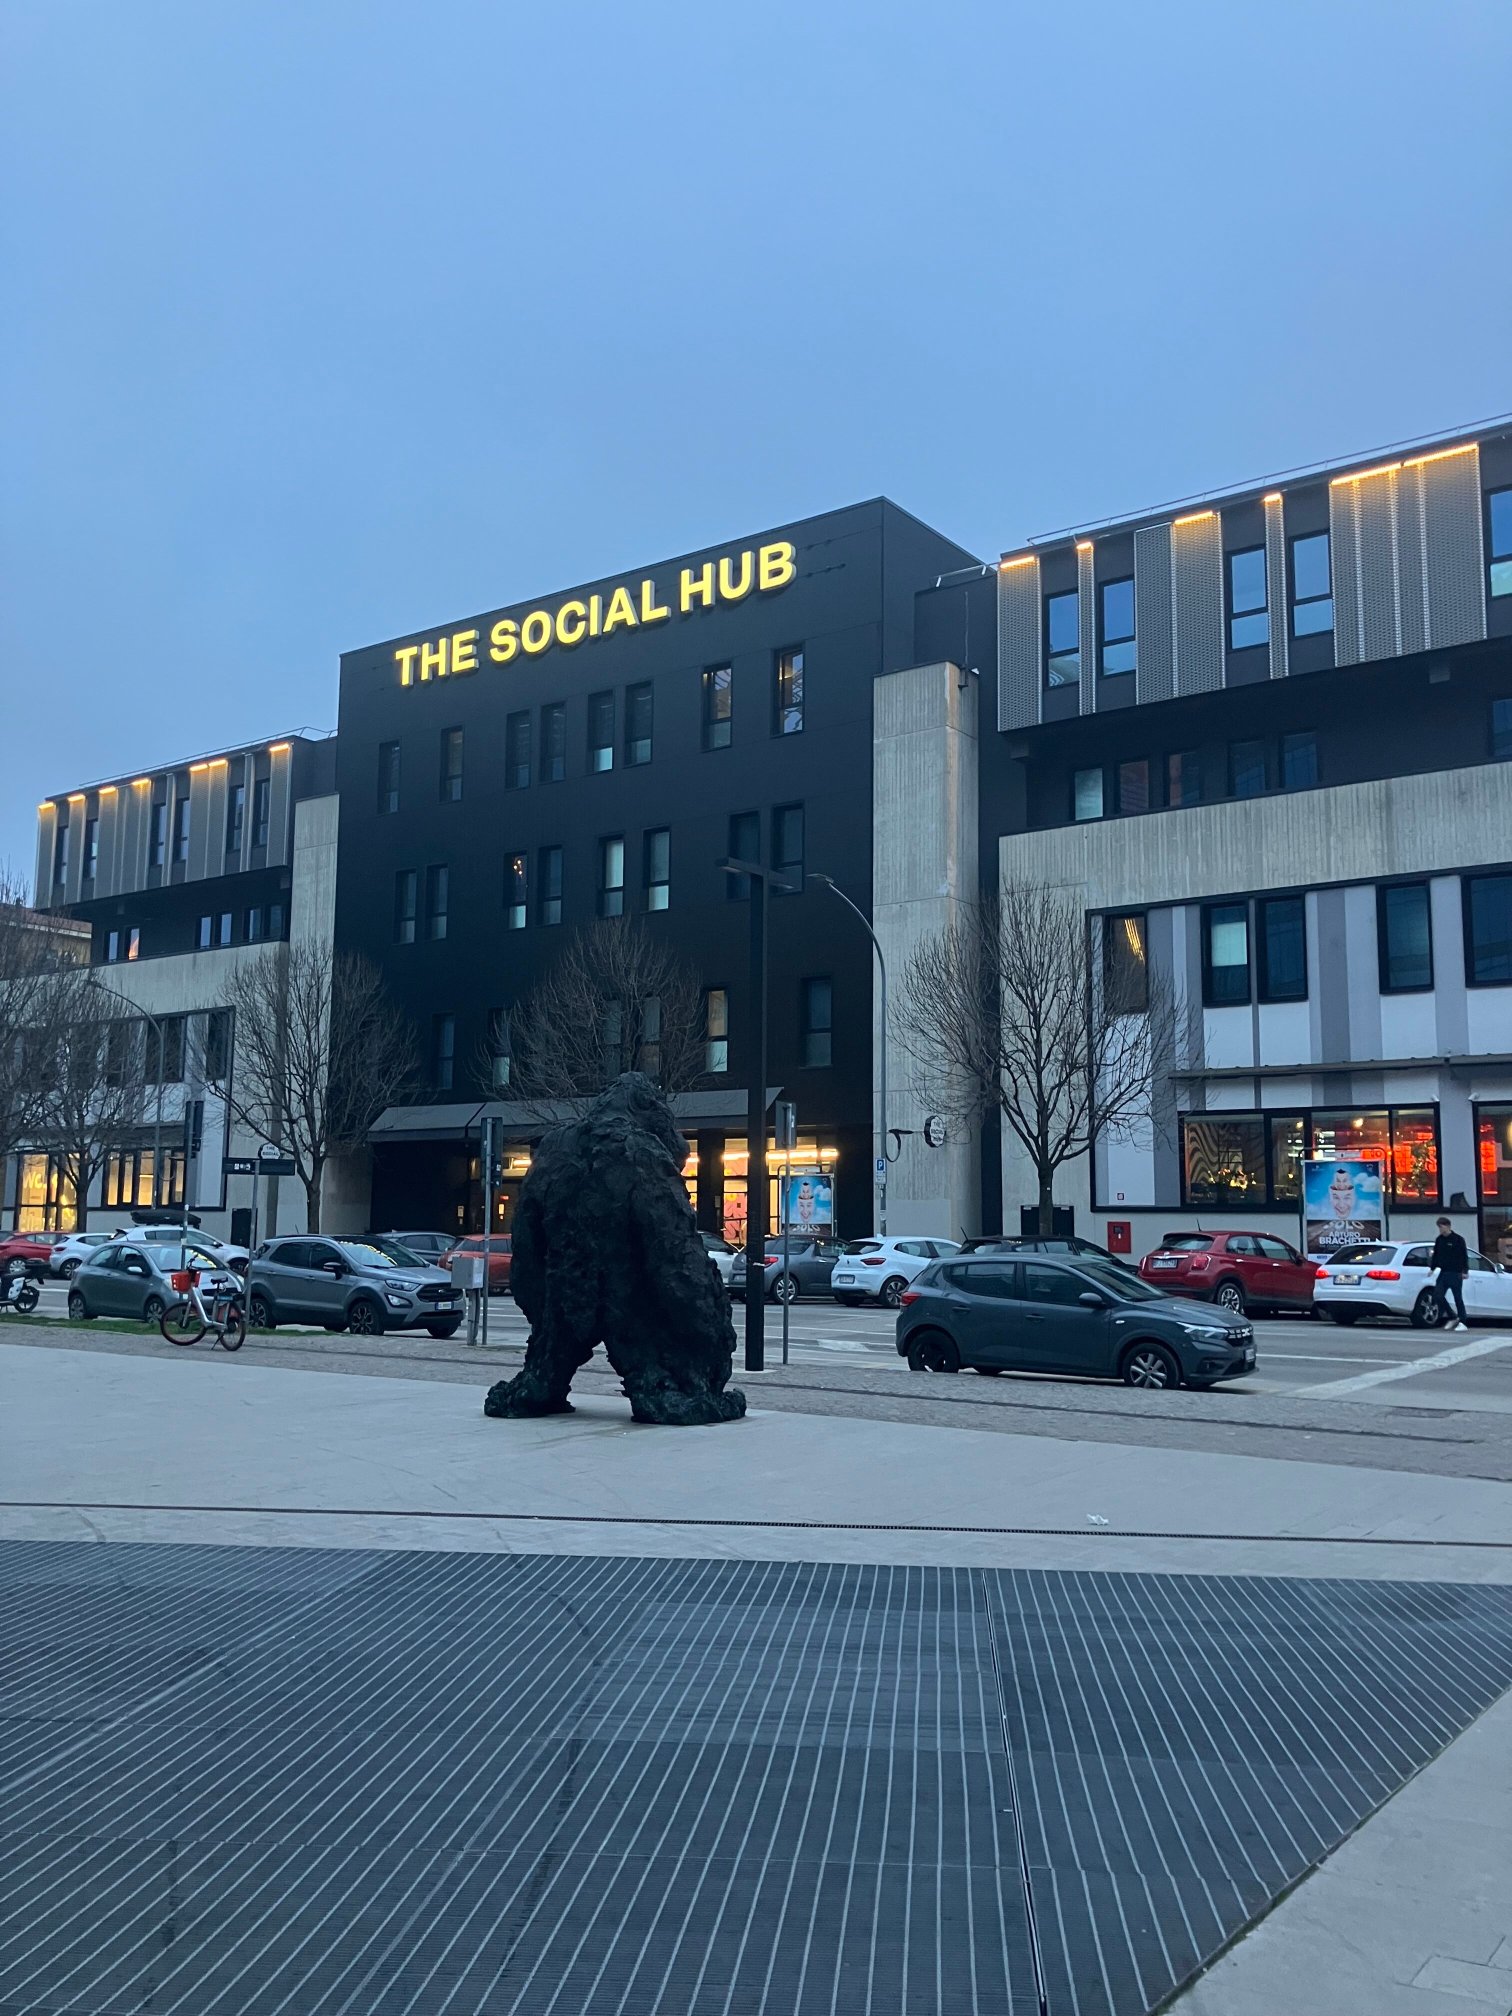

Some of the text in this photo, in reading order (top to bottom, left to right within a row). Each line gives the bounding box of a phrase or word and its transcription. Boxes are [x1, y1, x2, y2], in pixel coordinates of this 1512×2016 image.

[395, 541, 797, 687] THE SOCIAL HUB
[1329, 1231, 1360, 1239] ARTURO
